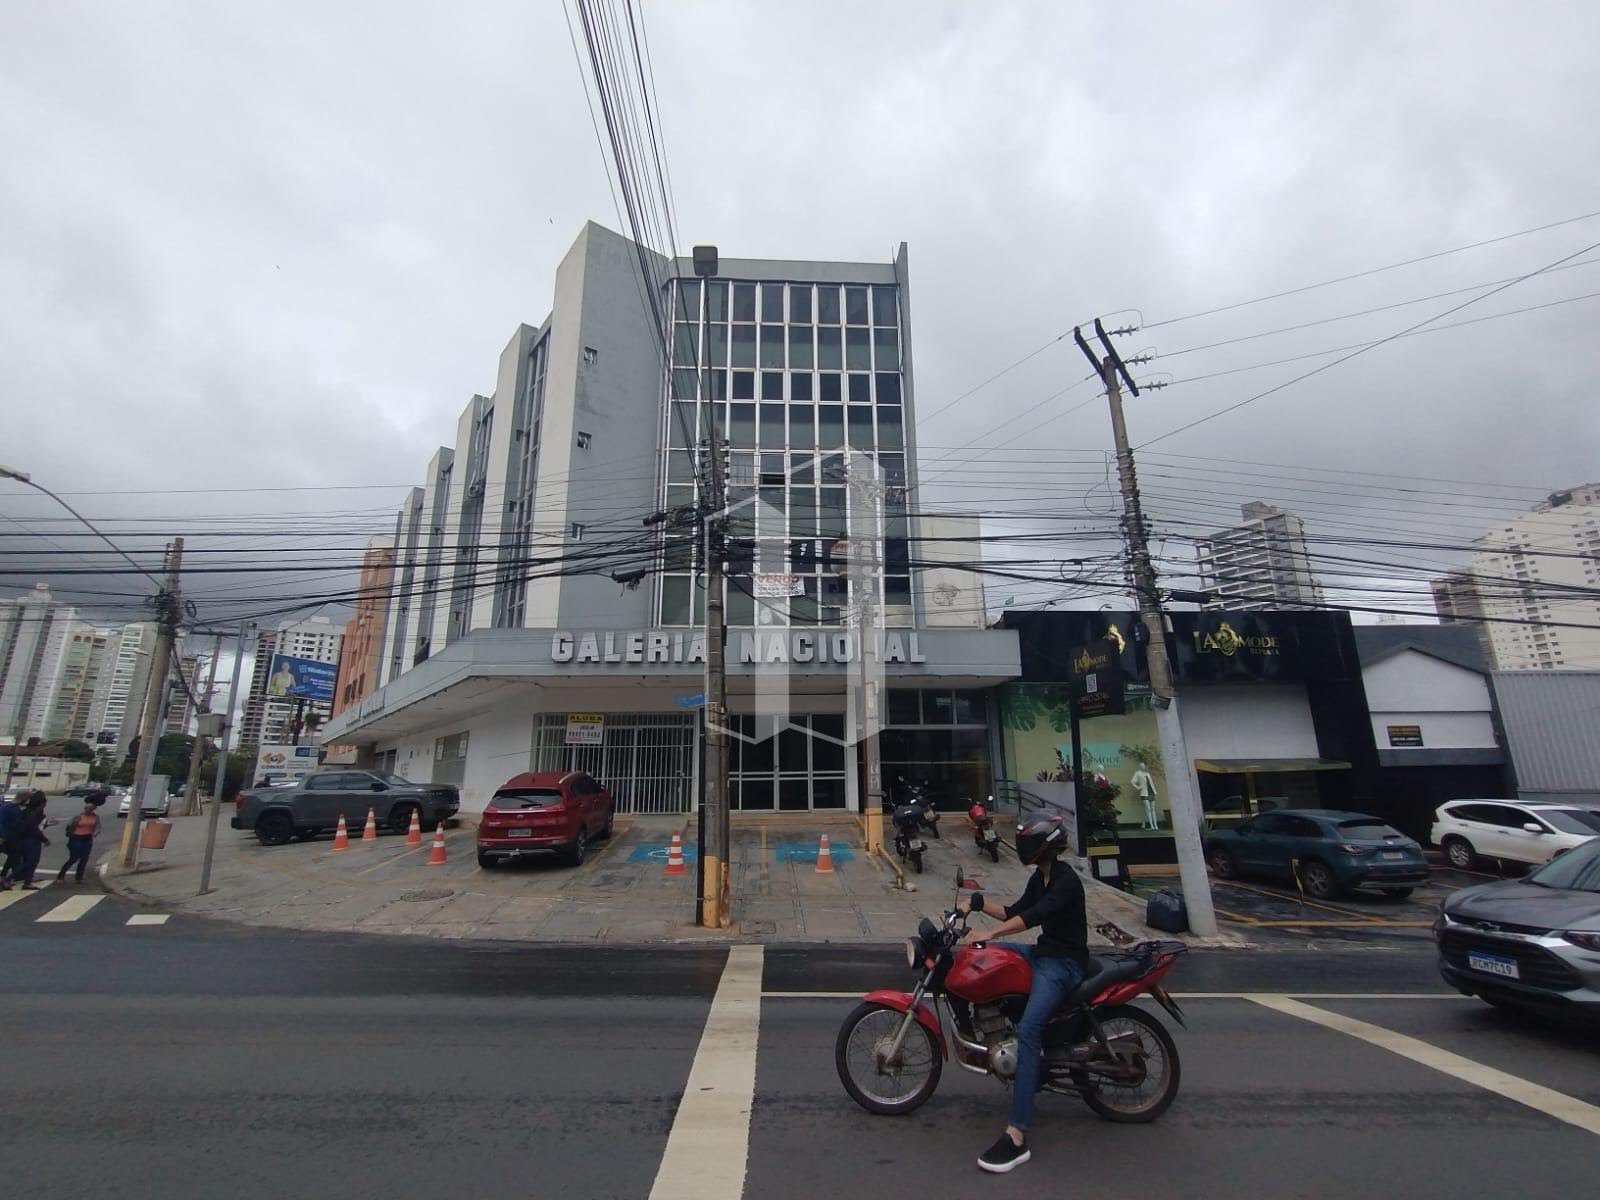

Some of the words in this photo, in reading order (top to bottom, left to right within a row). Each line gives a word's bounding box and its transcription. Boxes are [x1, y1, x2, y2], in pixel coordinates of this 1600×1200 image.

[551, 631, 708, 662] GALERIA
[740, 632, 926, 663] NACIOAL
[1238, 635, 1280, 648] MODE
